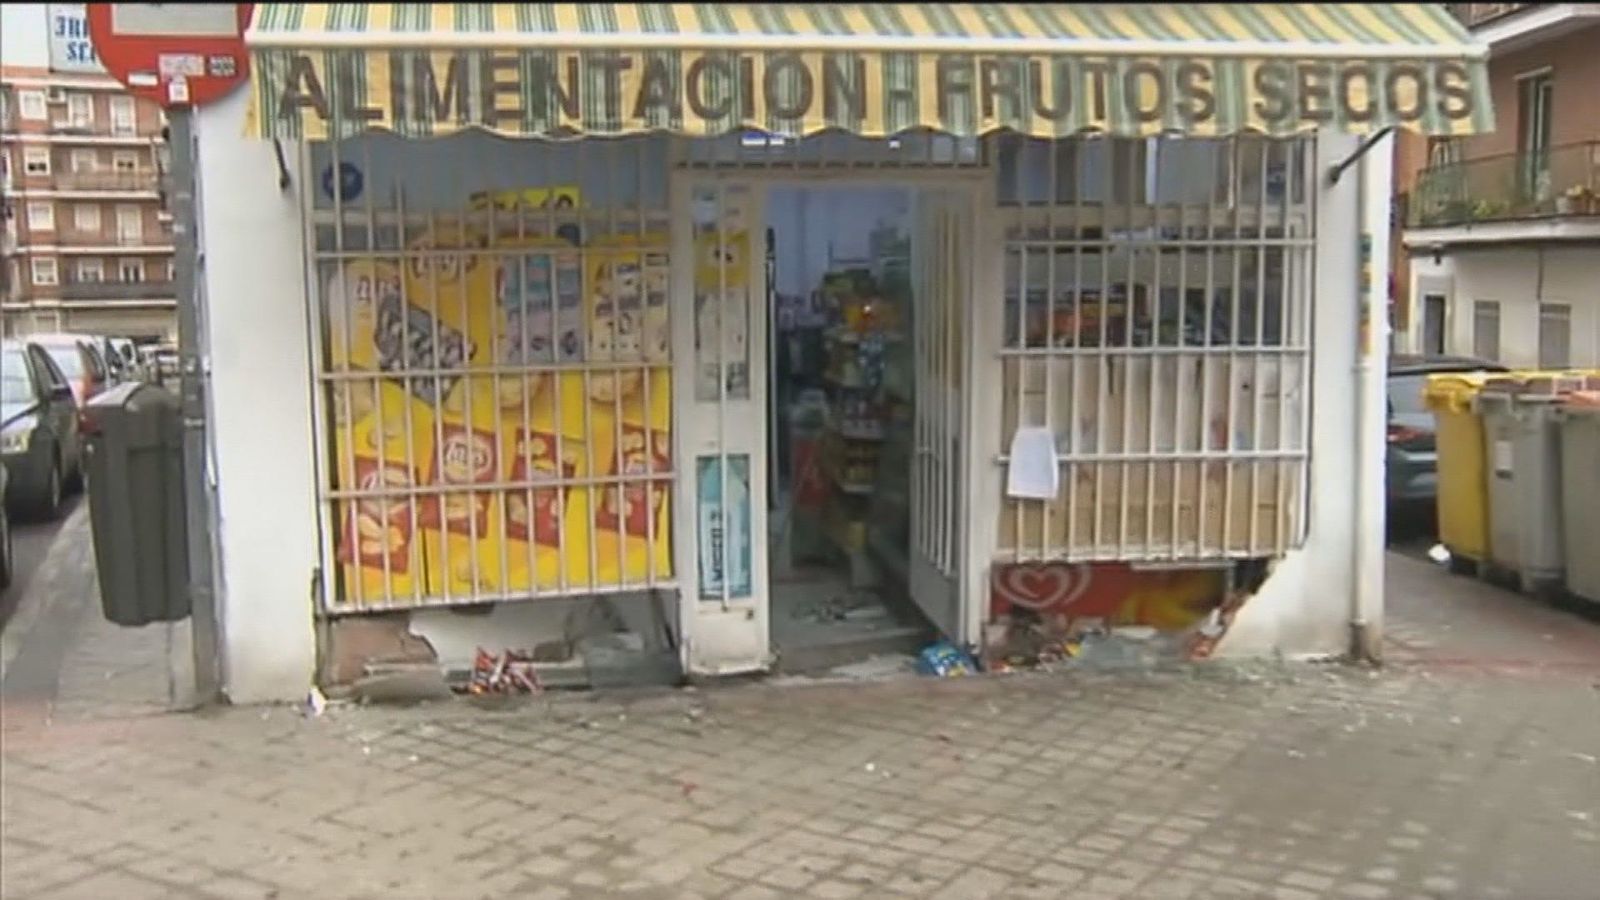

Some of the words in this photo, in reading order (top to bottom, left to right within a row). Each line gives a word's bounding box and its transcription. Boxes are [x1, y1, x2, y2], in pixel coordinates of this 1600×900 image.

[278, 55, 867, 120] ALIMENTACION
[936, 58, 1216, 122] FRUTOS
[1253, 61, 1474, 121] SECOS
